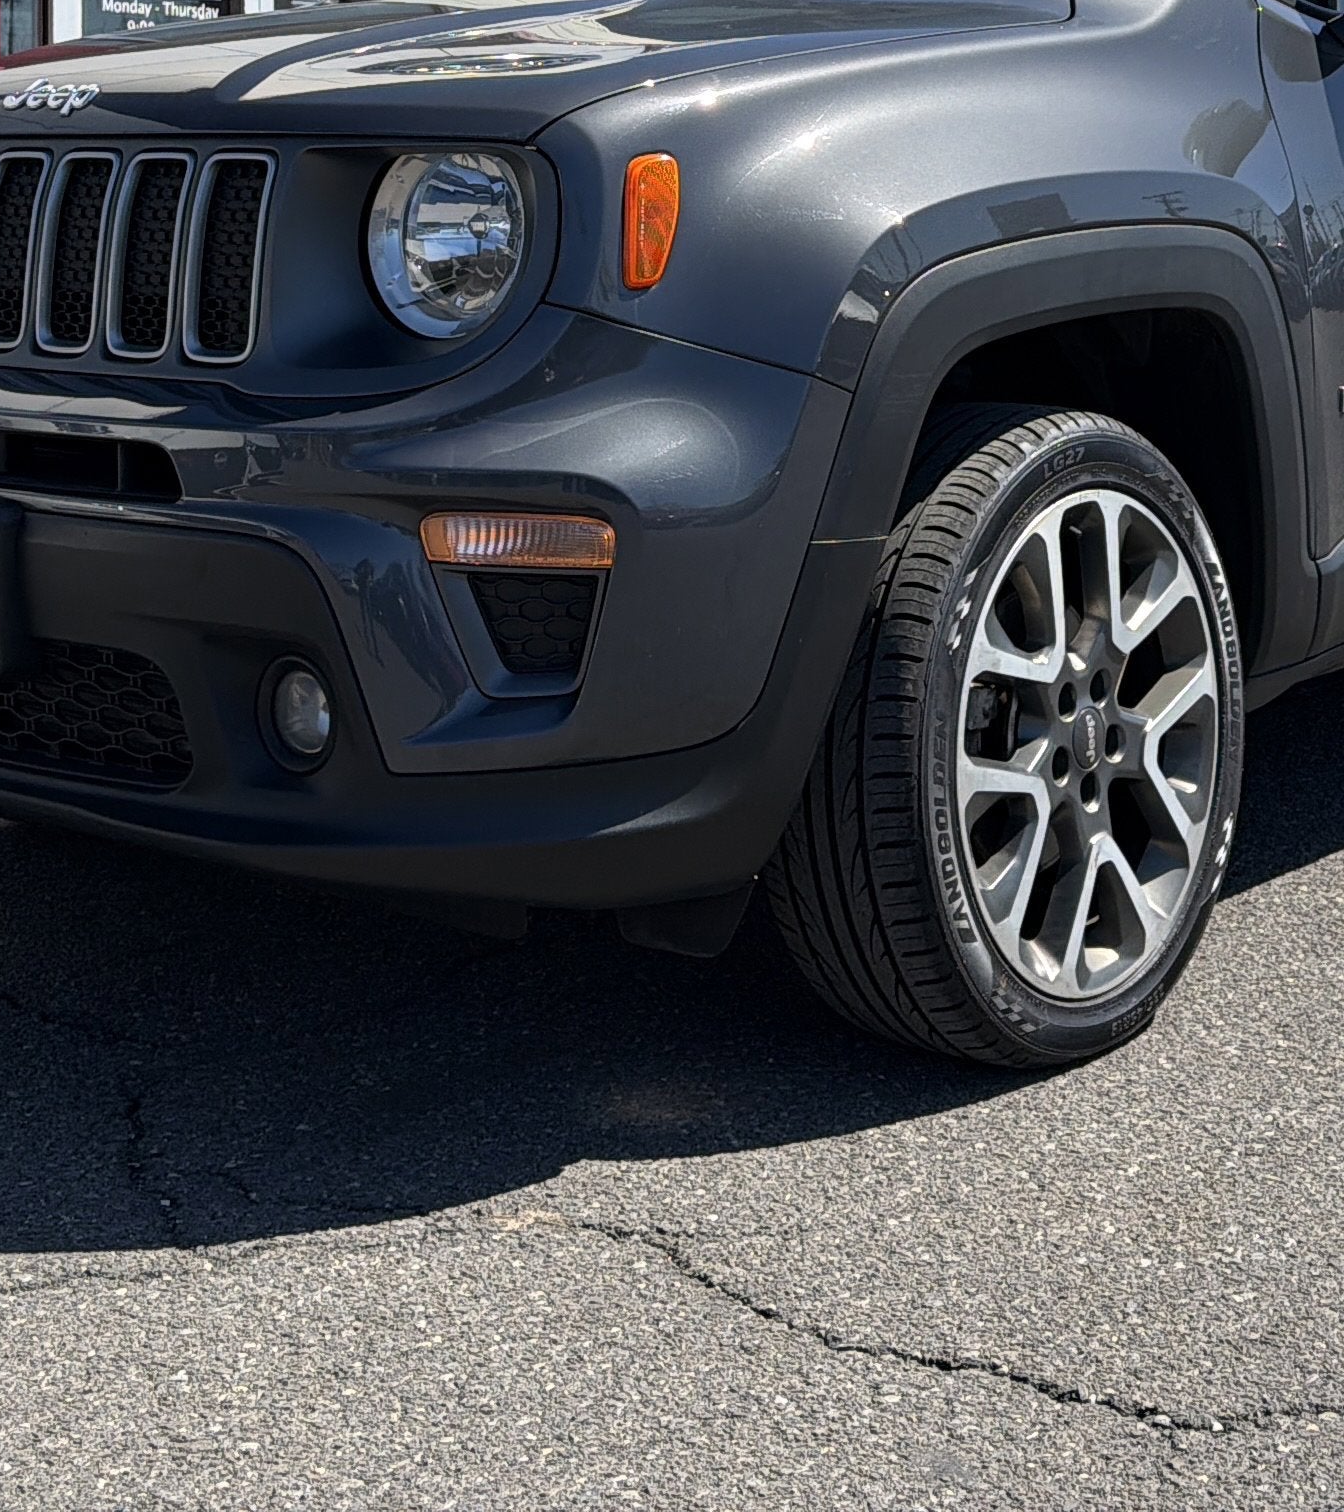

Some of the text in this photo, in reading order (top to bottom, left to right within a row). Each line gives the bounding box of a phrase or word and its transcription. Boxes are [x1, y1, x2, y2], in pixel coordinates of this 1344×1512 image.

[162, 0, 220, 21] Thursday
[2, 76, 102, 118] Jeep
[1085, 713, 1096, 763] Jeep
